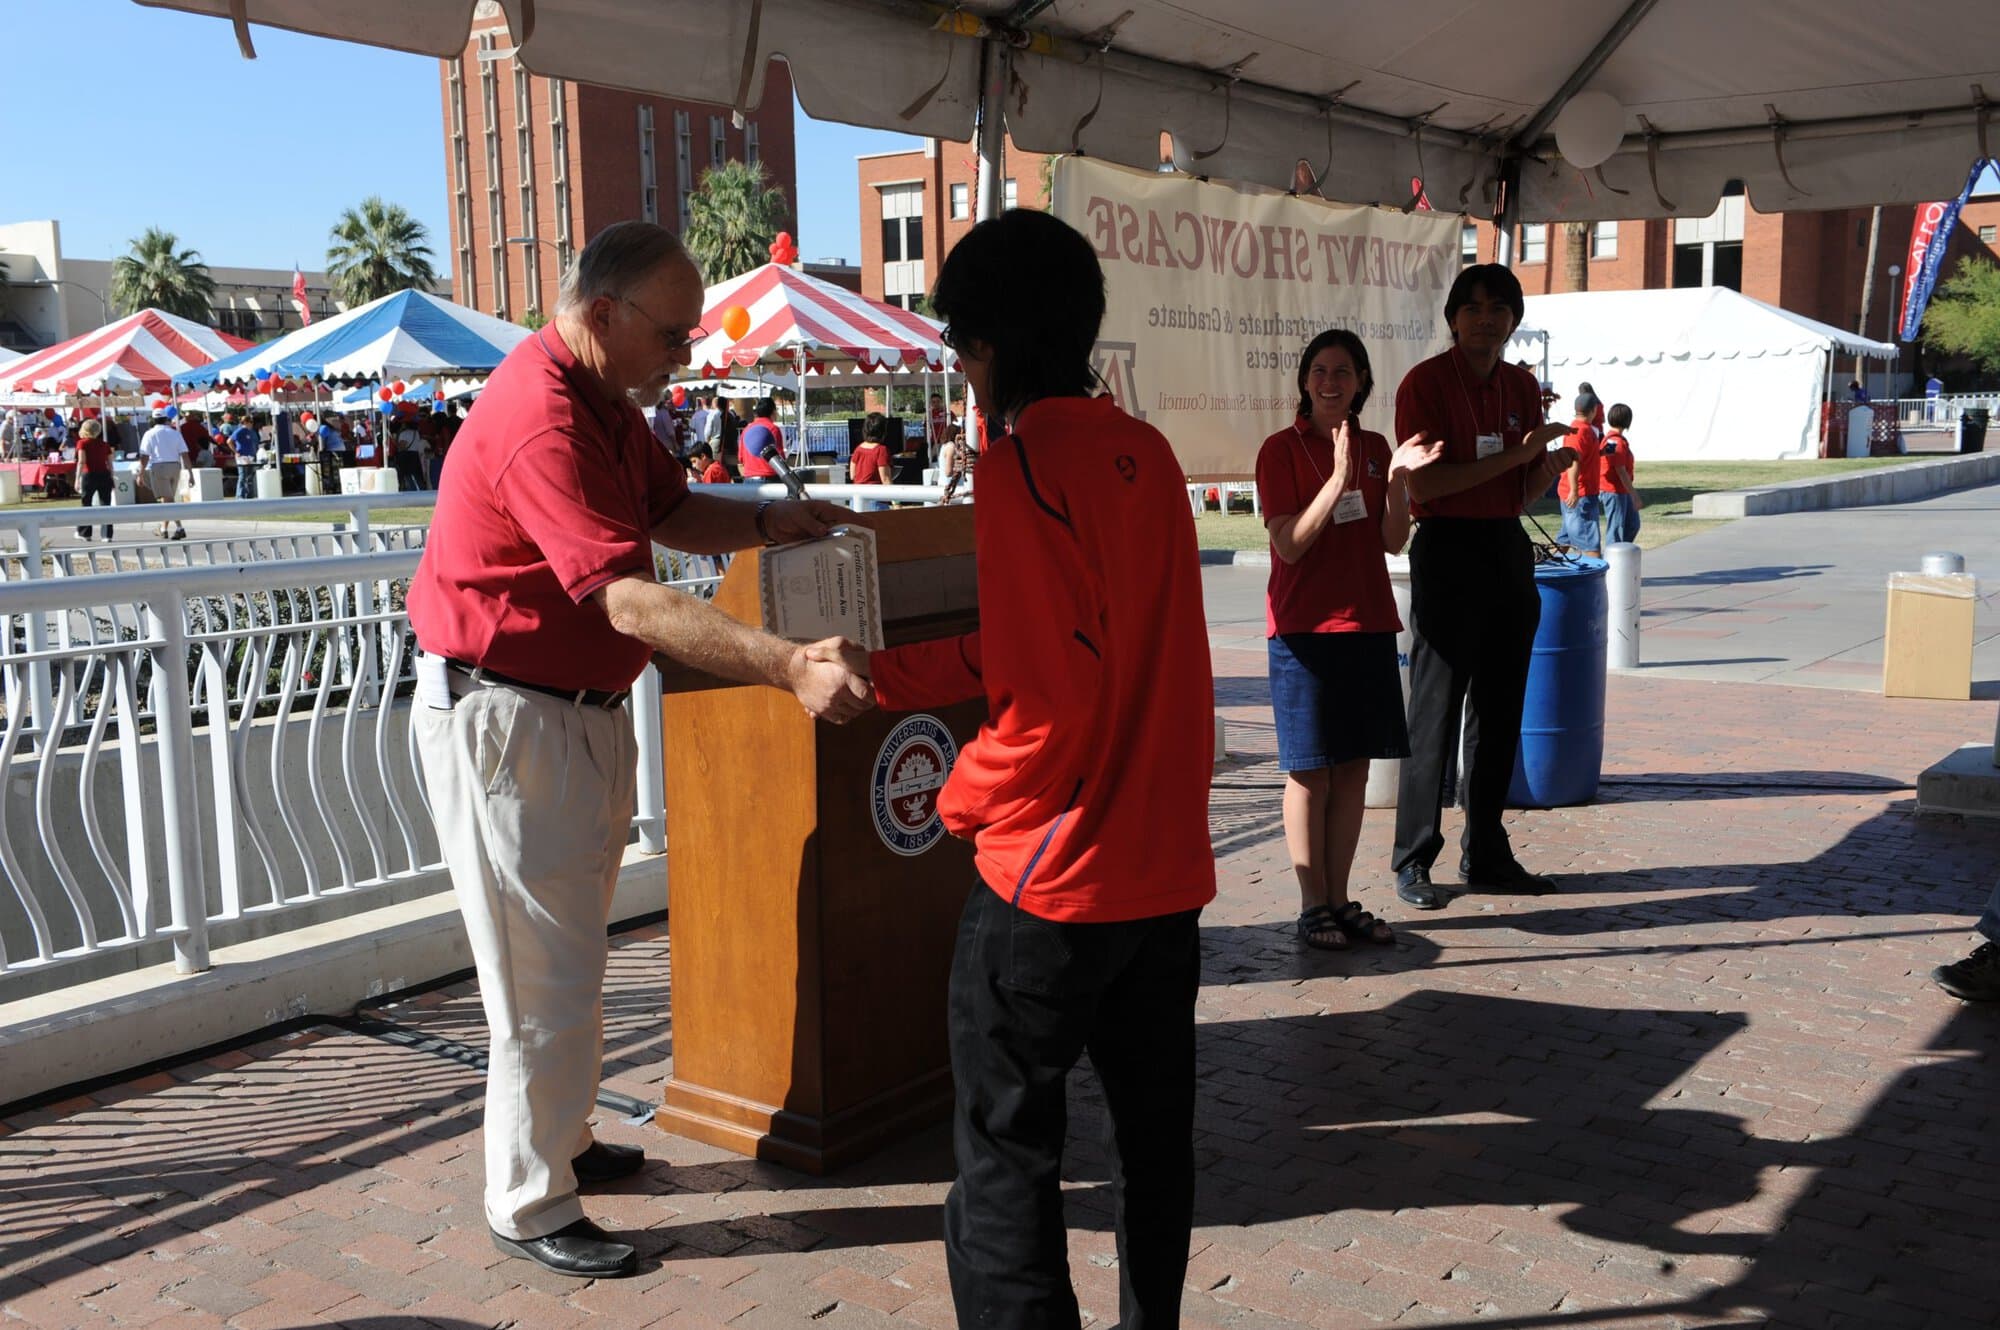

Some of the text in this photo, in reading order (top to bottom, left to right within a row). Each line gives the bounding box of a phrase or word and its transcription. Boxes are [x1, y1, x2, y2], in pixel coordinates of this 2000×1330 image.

[880, 722, 938, 767] VNIVERSITATIS
[876, 784, 900, 842] SIGILLVM
[903, 830, 931, 849] 1885
